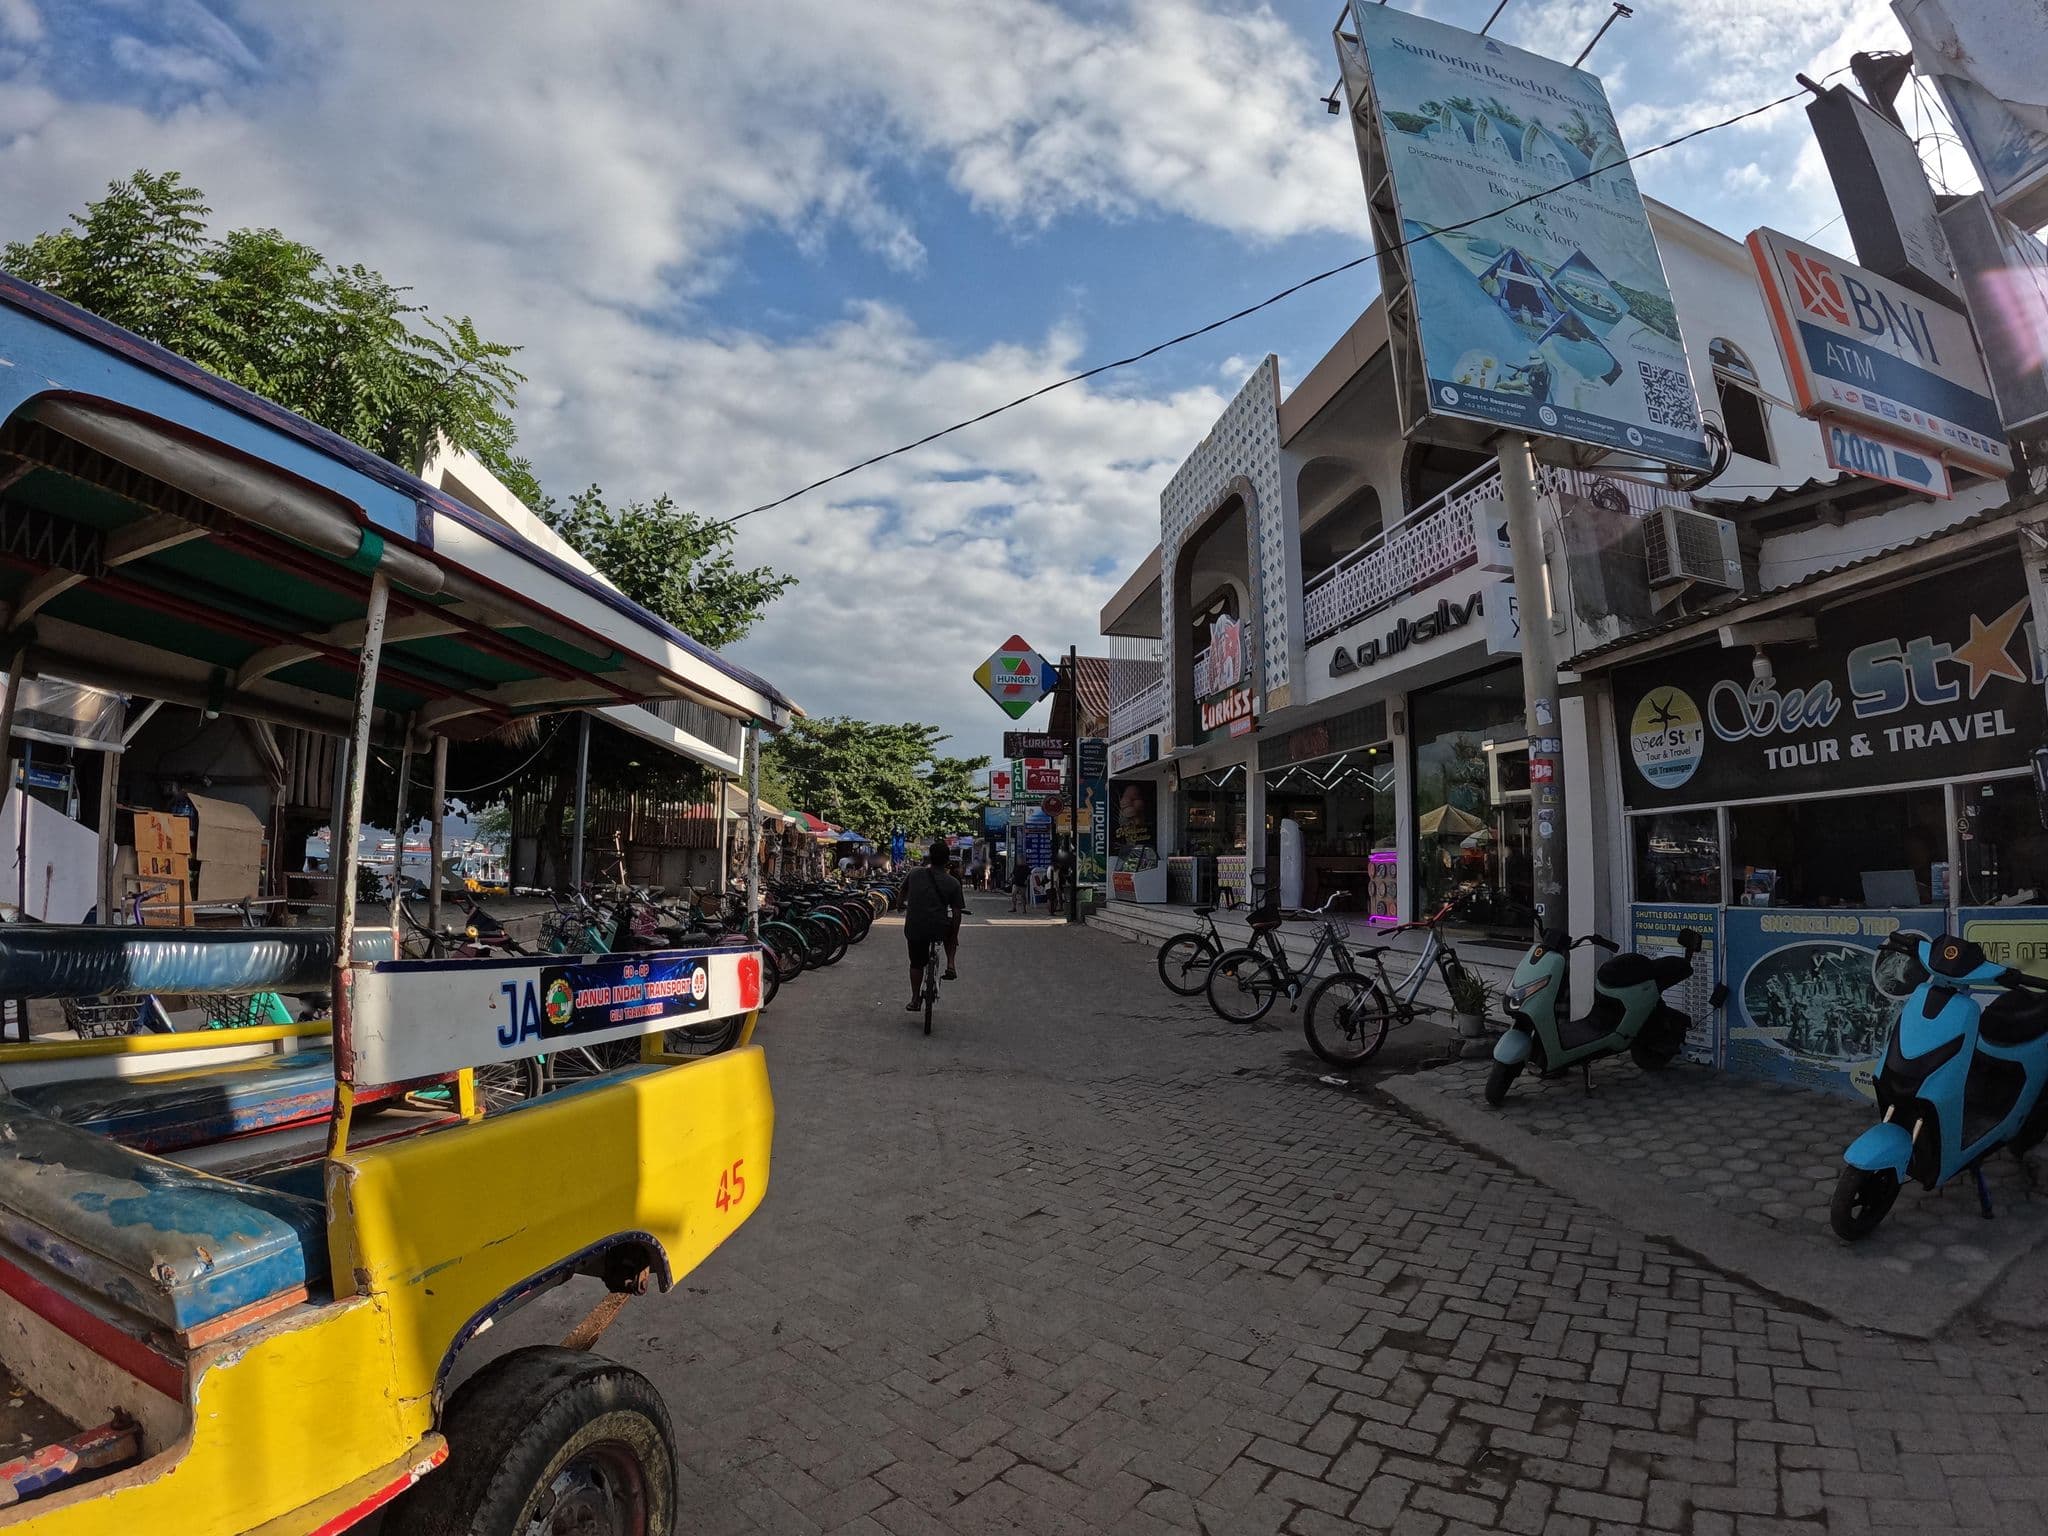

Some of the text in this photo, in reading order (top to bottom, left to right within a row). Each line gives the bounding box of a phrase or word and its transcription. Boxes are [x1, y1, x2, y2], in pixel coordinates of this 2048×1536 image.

[1391, 36, 1482, 75] Santorini
[1484, 64, 1542, 95] Beach
[1546, 86, 1602, 116] Resort
[1407, 145, 1456, 166] Discover
[1456, 158, 1474, 170] the
[1475, 163, 1508, 181] charm
[1510, 175, 1519, 184] of
[1521, 179, 1564, 198] Santoini
[1504, 216, 1581, 250] Save More
[1535, 211, 1547, 226] &
[1839, 273, 1941, 366] BNI
[1826, 341, 1876, 382] ATM
[1831, 427, 1890, 479] 20m
[996, 674, 1037, 684] HUNGRY
[1708, 675, 1841, 743] Sea
[1646, 753, 1661, 761] Tour
[1670, 746, 1691, 757] Travel
[1764, 709, 2015, 770] TOUR & TRAVEL
[1040, 775, 1059, 783] ATM
[1648, 768, 1659, 776] Gili
[1635, 910, 1662, 918] SHUTTLE
[1663, 911, 1682, 919] BOAT
[1683, 912, 1698, 920] AND
[1635, 922, 1654, 930] FROM
[1667, 924, 1714, 933] TRAWANGAN
[1761, 915, 1899, 936] SNORKELING TRIP
[575, 989, 611, 1009] JANUR
[613, 985, 642, 1004] INDAH
[644, 977, 691, 999] TRANSPORT
[610, 1002, 663, 1022] GILI TRAWANGAN
[715, 1158, 745, 1213] 45
